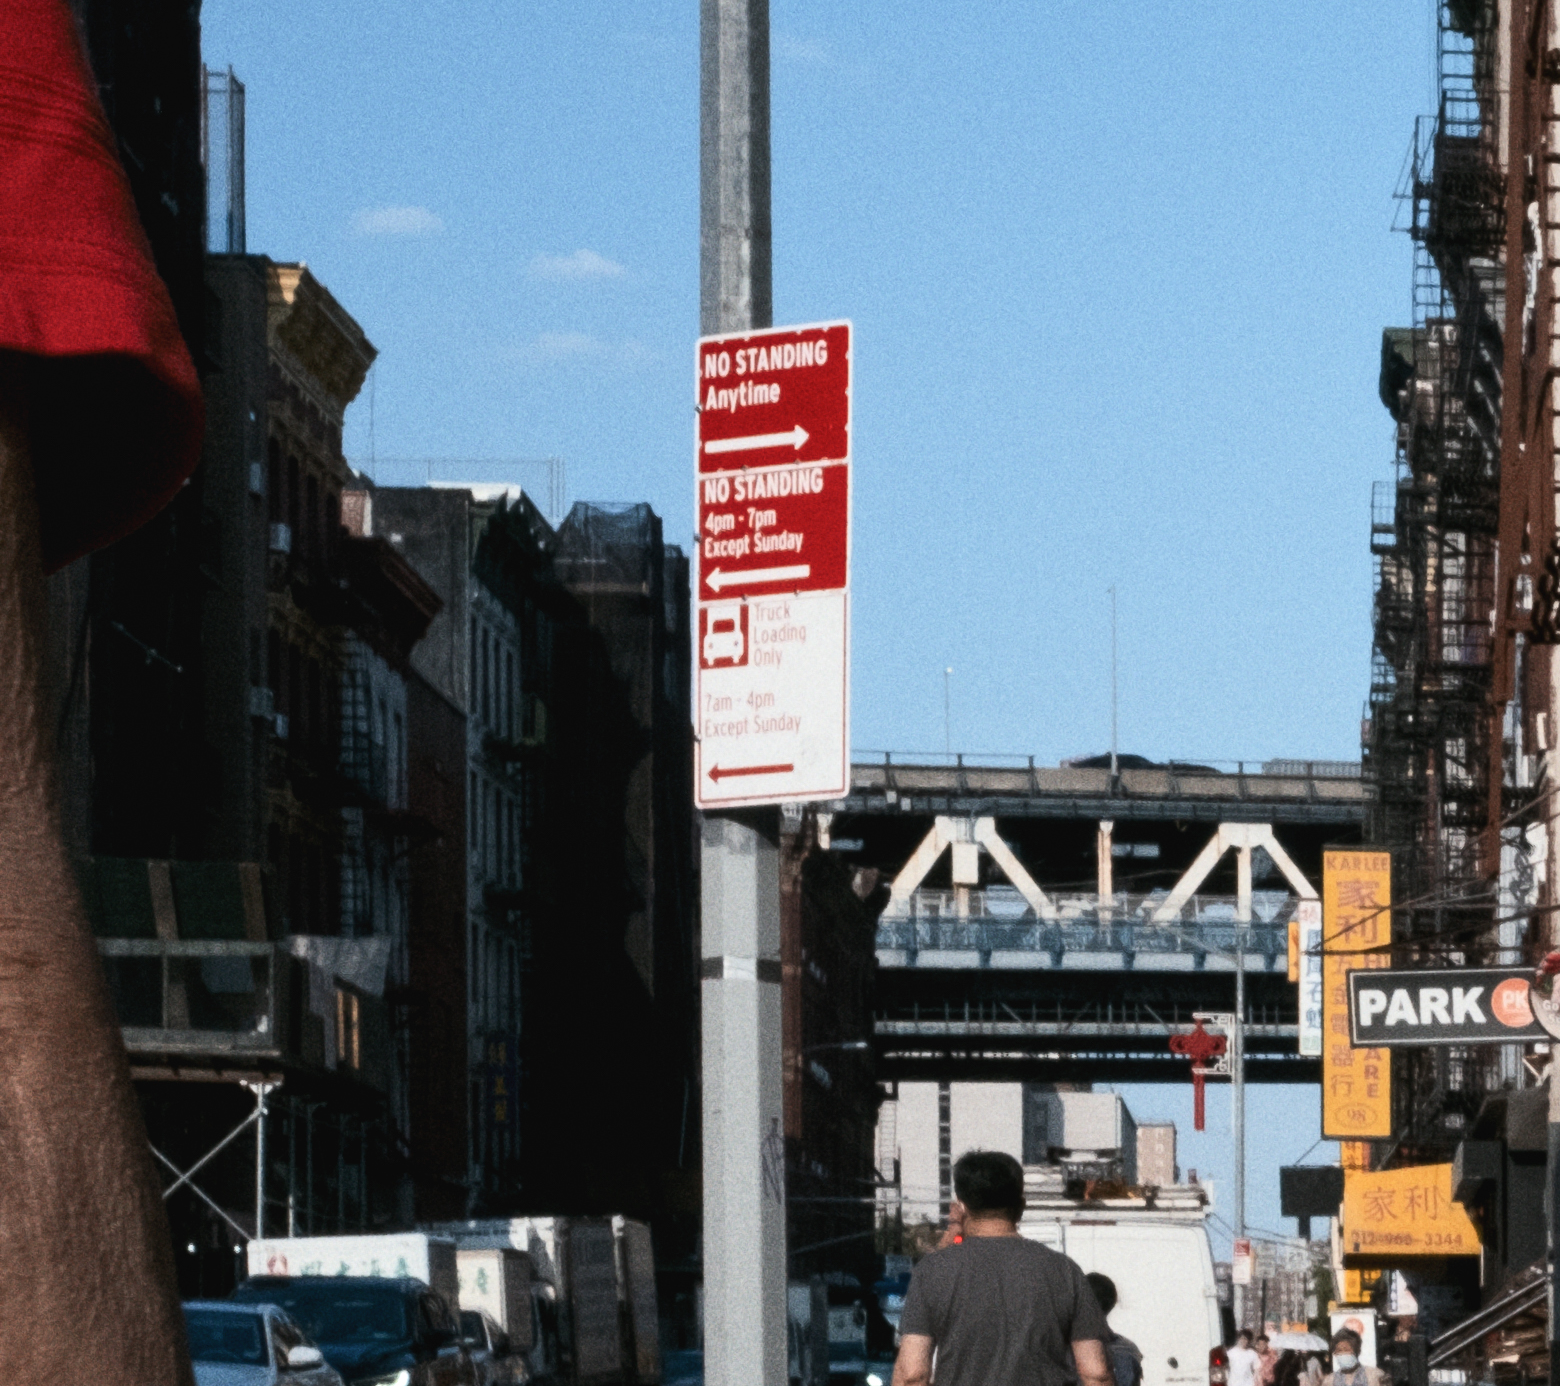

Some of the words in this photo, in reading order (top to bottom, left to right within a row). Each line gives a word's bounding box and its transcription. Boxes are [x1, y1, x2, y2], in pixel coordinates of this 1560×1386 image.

[705, 353, 730, 379] NO
[735, 340, 828, 376] STANDING
[705, 382, 781, 413] Anytime
[705, 478, 730, 505] NO
[734, 467, 824, 501] STANDING
[705, 512, 734, 536] 4pm
[747, 508, 777, 532] 7pm
[705, 532, 750, 559] Except
[754, 530, 804, 554] Sunday
[754, 603, 791, 621] Truck
[754, 623, 807, 645] Loading
[754, 648, 783, 669] Only
[705, 693, 733, 711] 7am
[747, 691, 776, 711] 4pm
[705, 715, 749, 738] Except
[754, 712, 801, 736] Sunday
[1325, 855, 1389, 873] KARLEE
[1358, 986, 1488, 1026] PARK
[1543, 1000, 1560, 1012] Go
[1363, 1185, 1437, 1222] 家利
